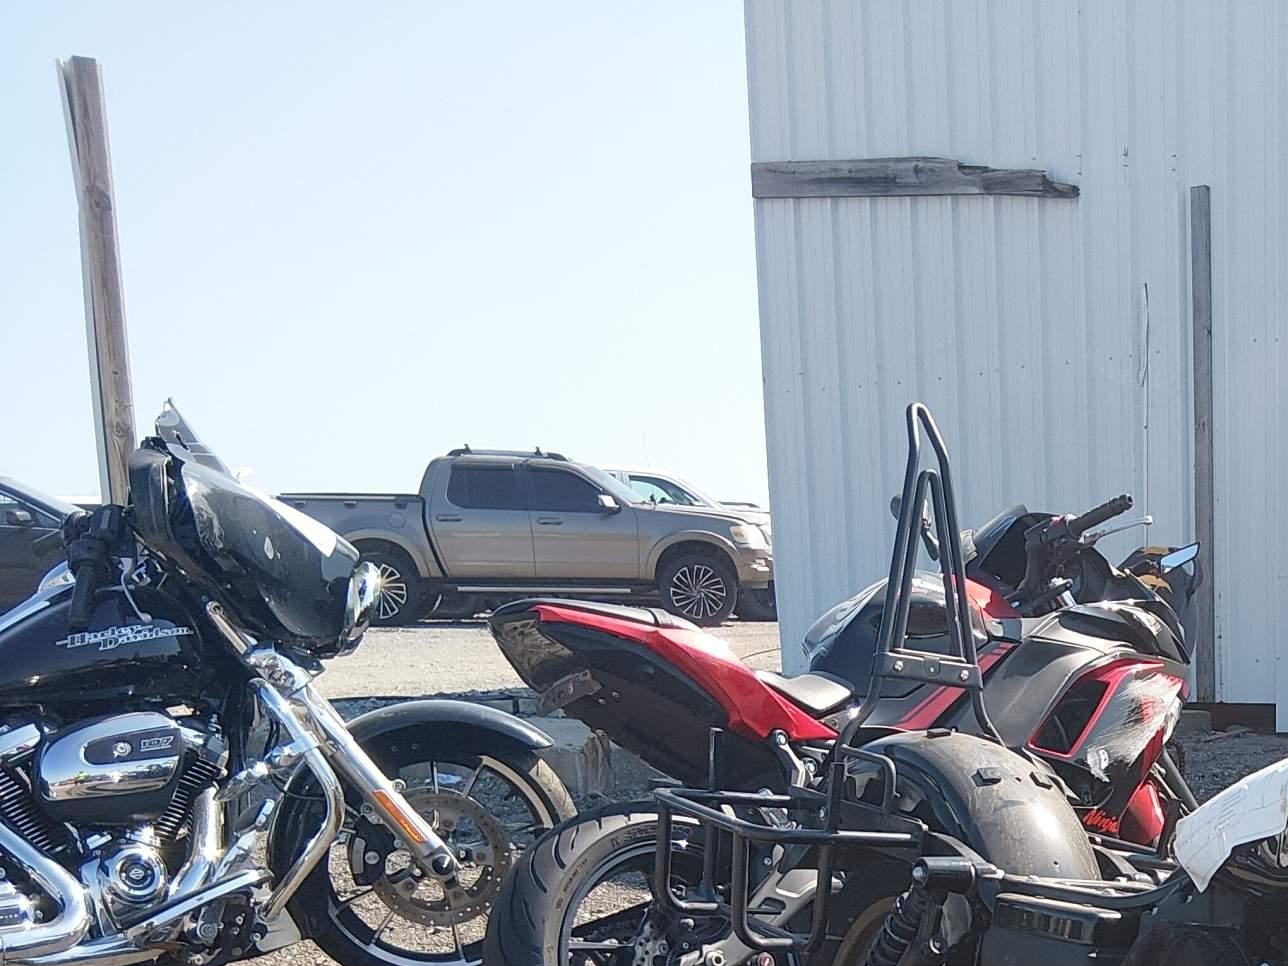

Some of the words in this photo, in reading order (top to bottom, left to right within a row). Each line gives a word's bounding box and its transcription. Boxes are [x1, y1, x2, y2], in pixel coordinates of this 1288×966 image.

[99, 627, 194, 650] Davidson
[140, 736, 174, 751] 107
[1083, 809, 1118, 833] Ninja
